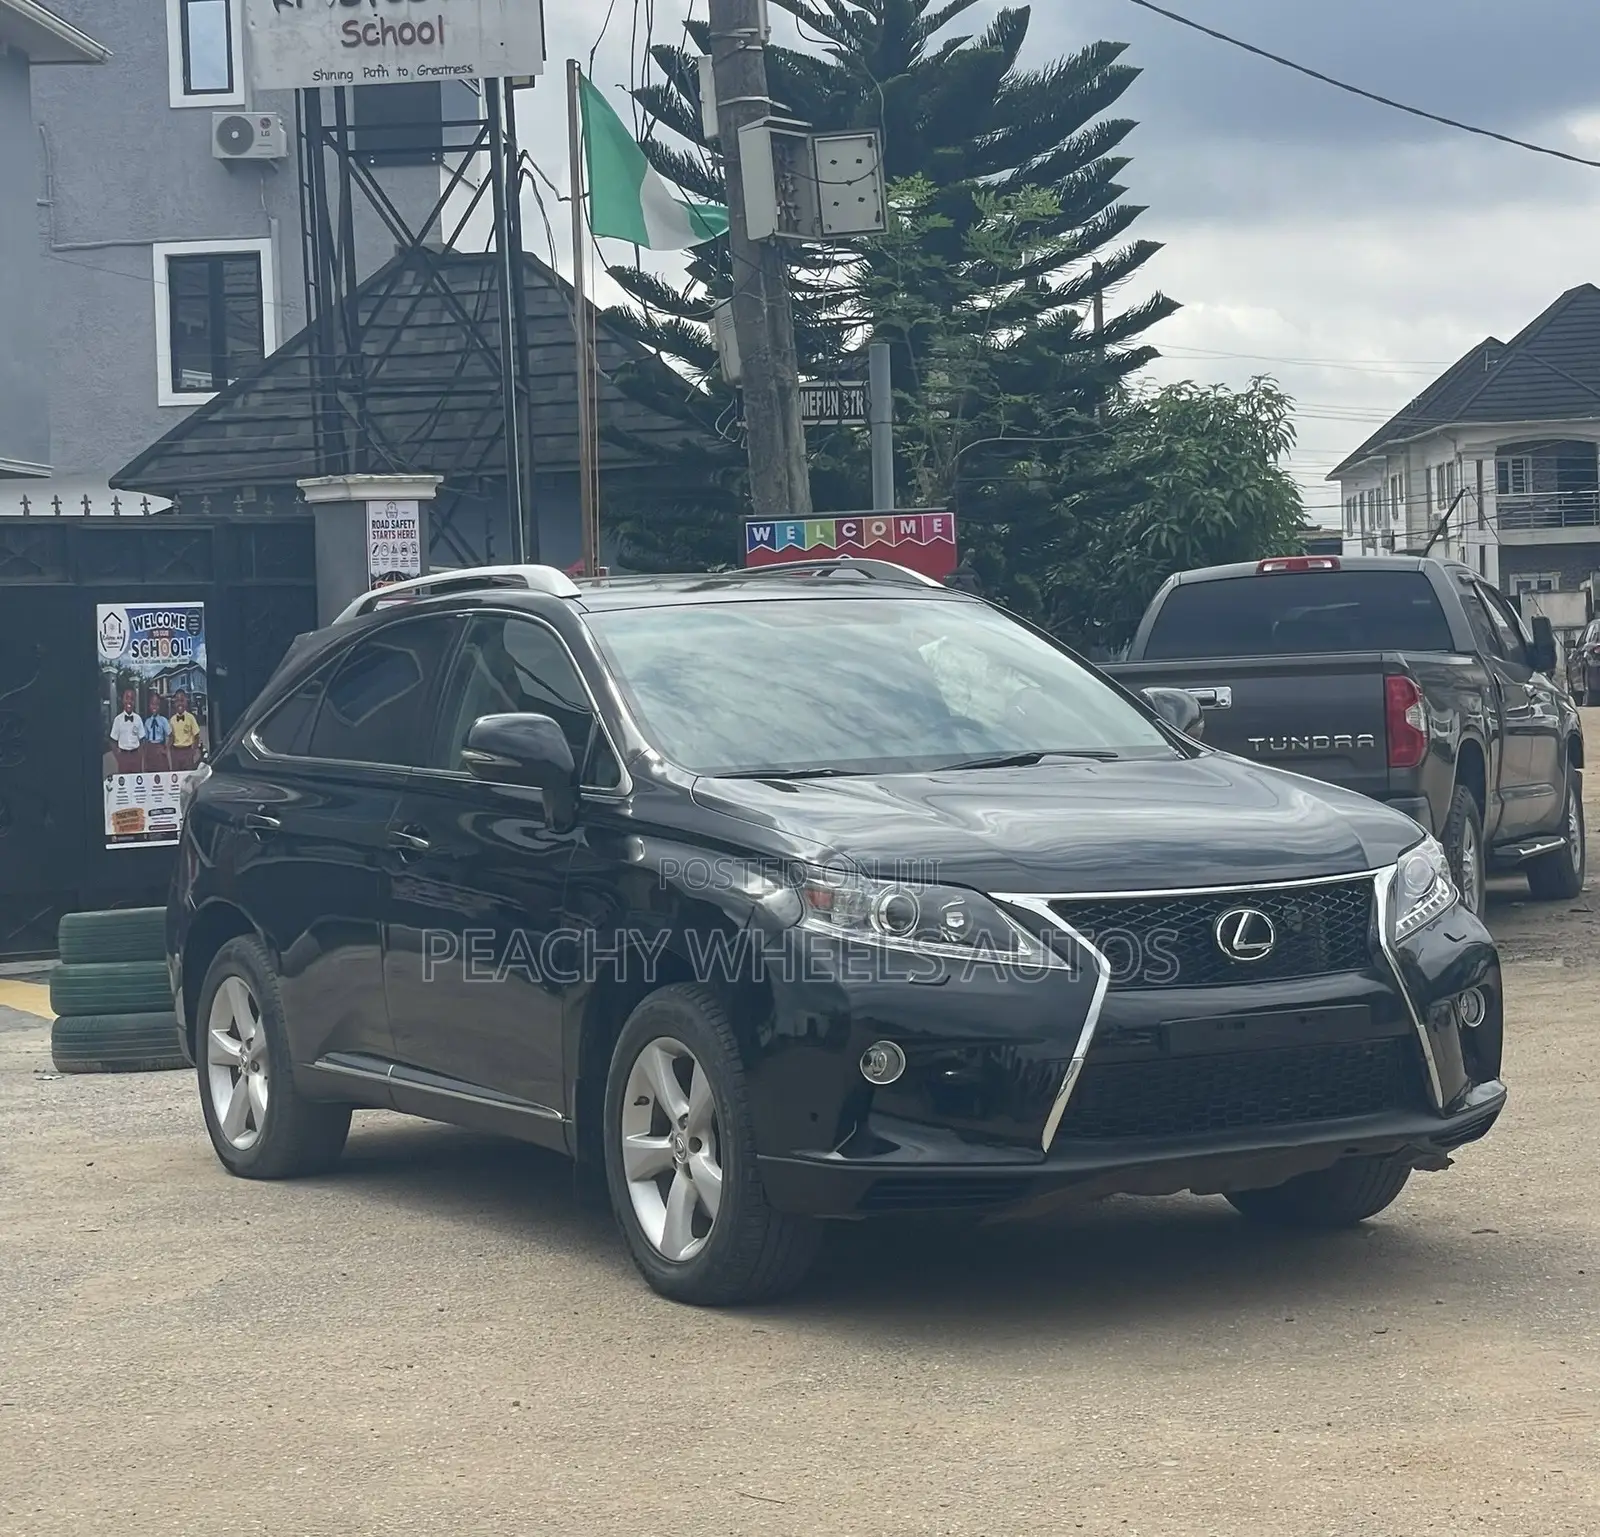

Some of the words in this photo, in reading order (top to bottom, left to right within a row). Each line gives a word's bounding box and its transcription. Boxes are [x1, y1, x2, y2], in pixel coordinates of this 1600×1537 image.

[341, 15, 444, 48] School
[312, 68, 354, 83] Shining
[363, 64, 390, 78] Path
[397, 66, 409, 77] to
[417, 63, 474, 77] Greatness
[371, 519, 390, 529] ROAD
[391, 519, 416, 529] SAFETY
[372, 530, 396, 539] STARTS
[397, 529, 417, 539] HERE!
[752, 518, 943, 542] WELCOME
[131, 612, 186, 632] WELCOME
[131, 637, 192, 658] SCHOOL!
[1248, 733, 1375, 751] TUNDRA
